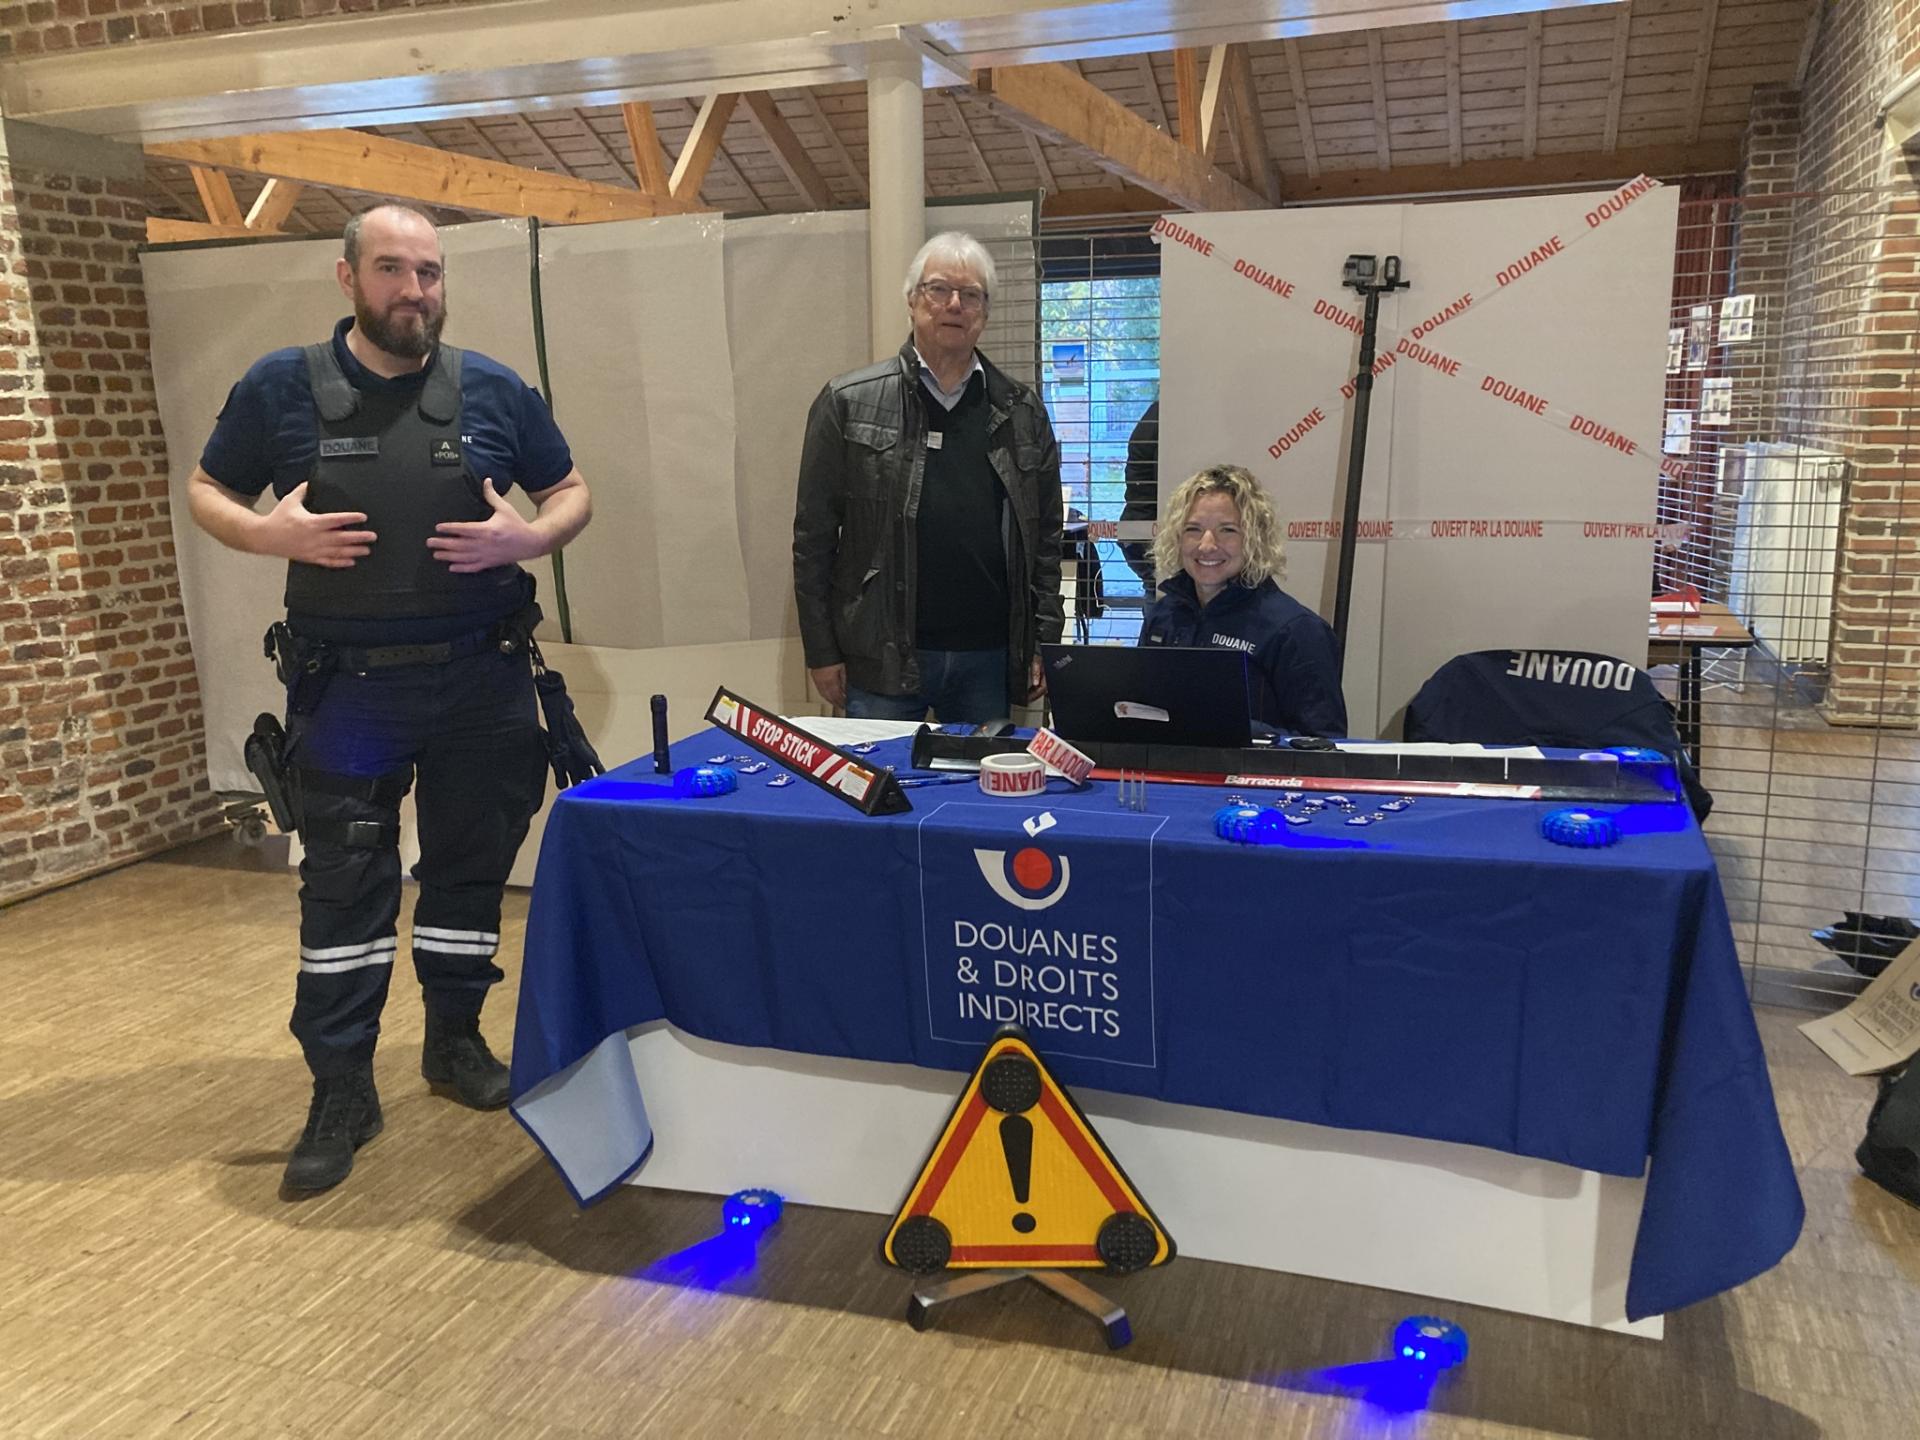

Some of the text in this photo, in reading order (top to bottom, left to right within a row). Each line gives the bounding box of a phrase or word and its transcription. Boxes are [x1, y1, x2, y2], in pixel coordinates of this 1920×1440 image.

[1268, 408, 1324, 460] DOUANE
[1495, 234, 1566, 288] DOUANE
[1584, 174, 1657, 229] DOUANE
[1154, 217, 1214, 257] DOUANE
[1232, 258, 1296, 299] DOUANE
[1313, 298, 1364, 337] DOUAN
[1395, 337, 1462, 377] DOUANE
[1480, 375, 1549, 416] DOUANE
[1569, 415, 1639, 456] DOUANE
[322, 441, 376, 453] DOUANE
[441, 441, 450, 450] A
[1288, 521, 1322, 538] OUVERT
[1324, 521, 1342, 538] PAR
[1431, 520, 1543, 538] OUVERT PAR LA DOUANE
[1583, 521, 1621, 538] OUVERT
[1212, 633, 1256, 655] DOUANE
[1506, 649, 1636, 692] DOUANE
[752, 717, 819, 768] STOP STICK
[1225, 775, 1303, 788] Barracuda
[954, 920, 1119, 965] DOUANES
[957, 956, 1120, 1001] & DROITS
[959, 992, 1121, 1038] INDIRECTS
